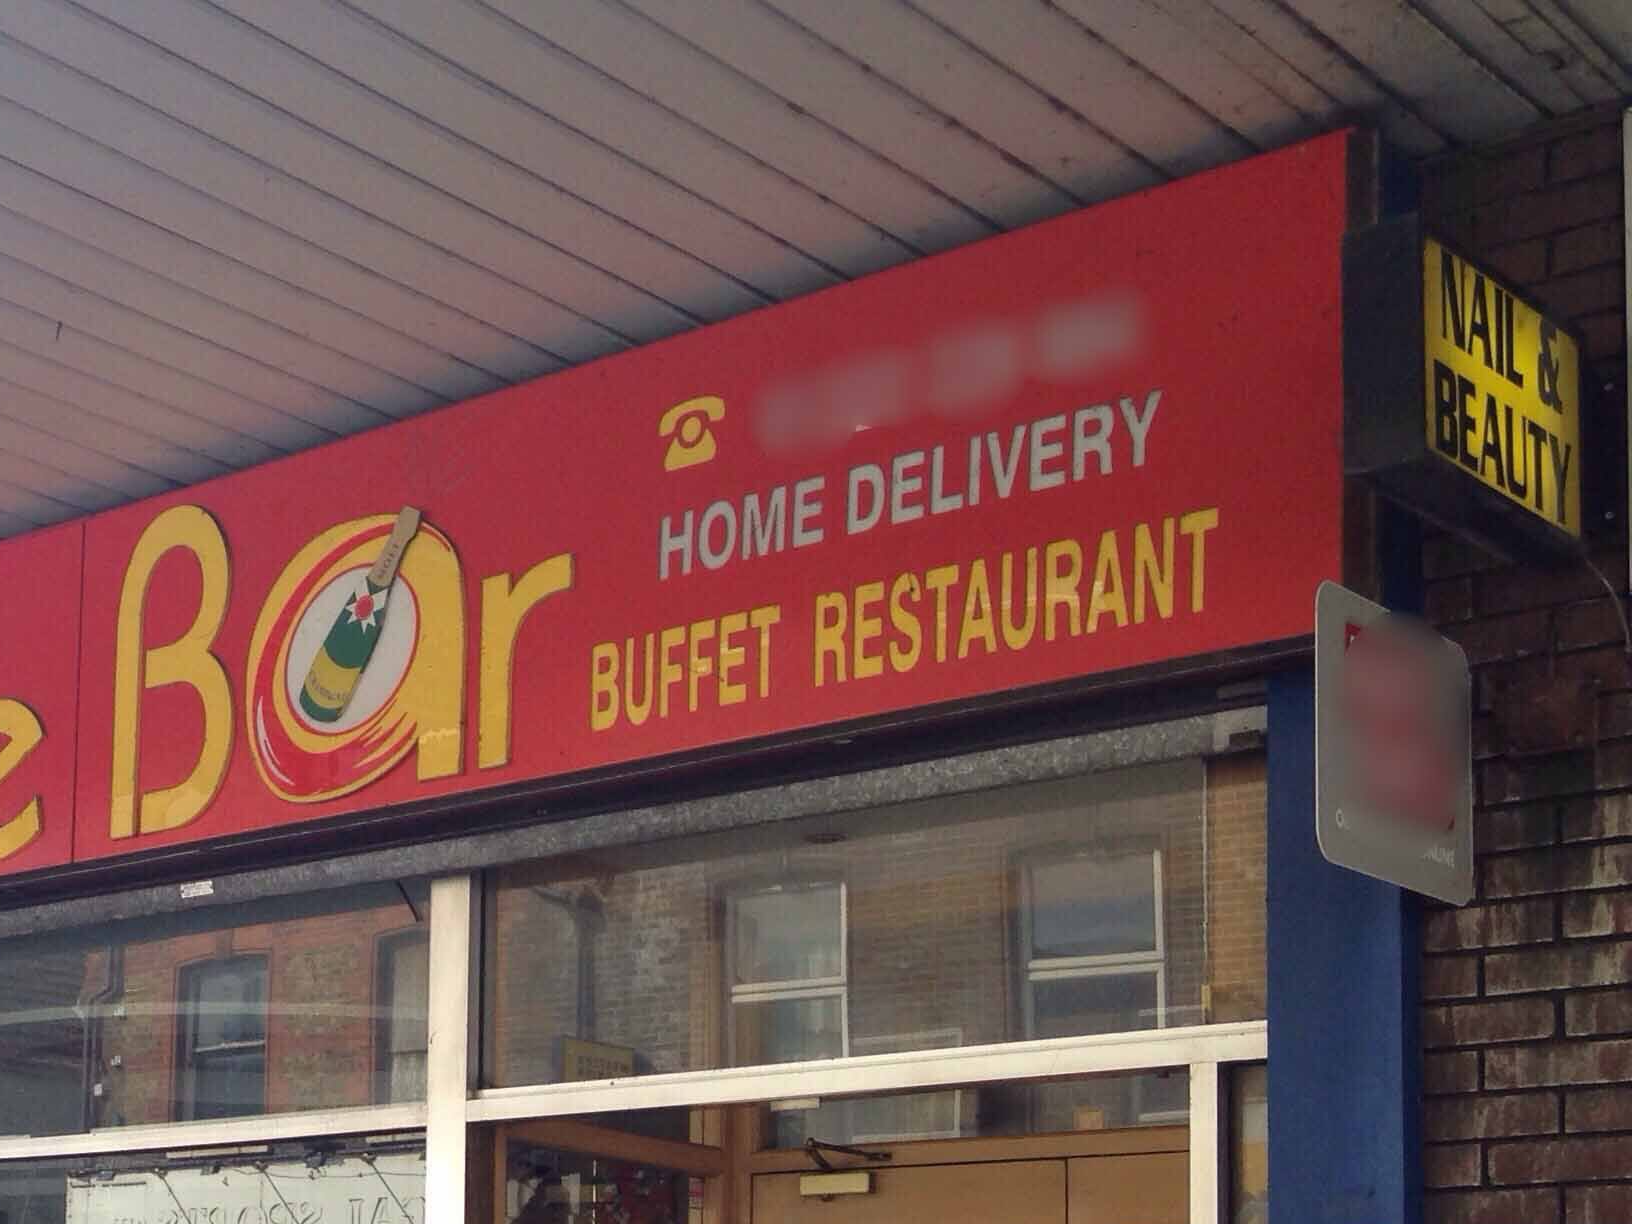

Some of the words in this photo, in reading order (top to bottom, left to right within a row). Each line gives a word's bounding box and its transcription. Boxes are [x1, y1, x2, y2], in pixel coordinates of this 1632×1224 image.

[1441, 250, 1524, 389] NAIL
[1537, 315, 1563, 414] &
[658, 477, 825, 581] HOME
[846, 389, 1162, 535] DELIVERY
[1432, 358, 1572, 526] BEAUTY
[110, 505, 574, 838] Bar
[590, 606, 781, 731] BUFFET
[814, 507, 1219, 688] RESTAURANT
